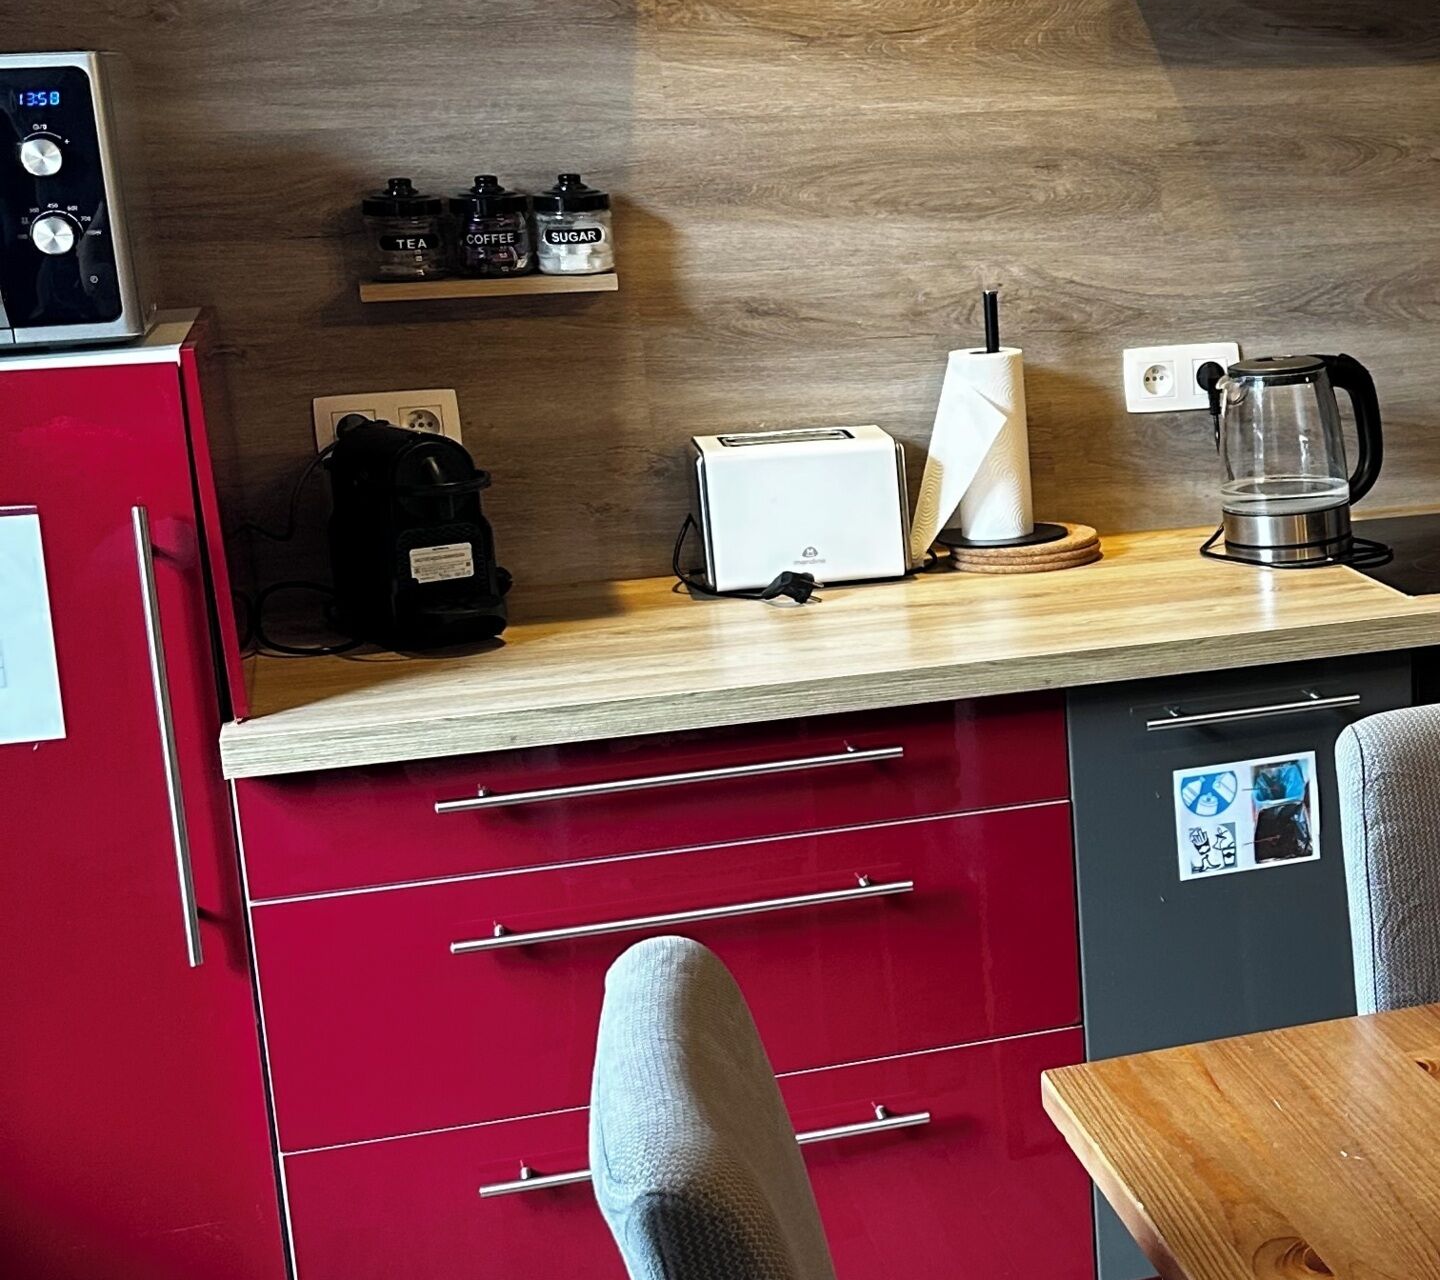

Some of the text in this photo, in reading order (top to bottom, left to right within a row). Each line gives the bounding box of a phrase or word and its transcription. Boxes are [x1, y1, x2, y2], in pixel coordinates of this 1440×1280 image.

[466, 232, 515, 245] COFFEE
[550, 231, 597, 243] SUGAR
[396, 238, 428, 249] TEA
